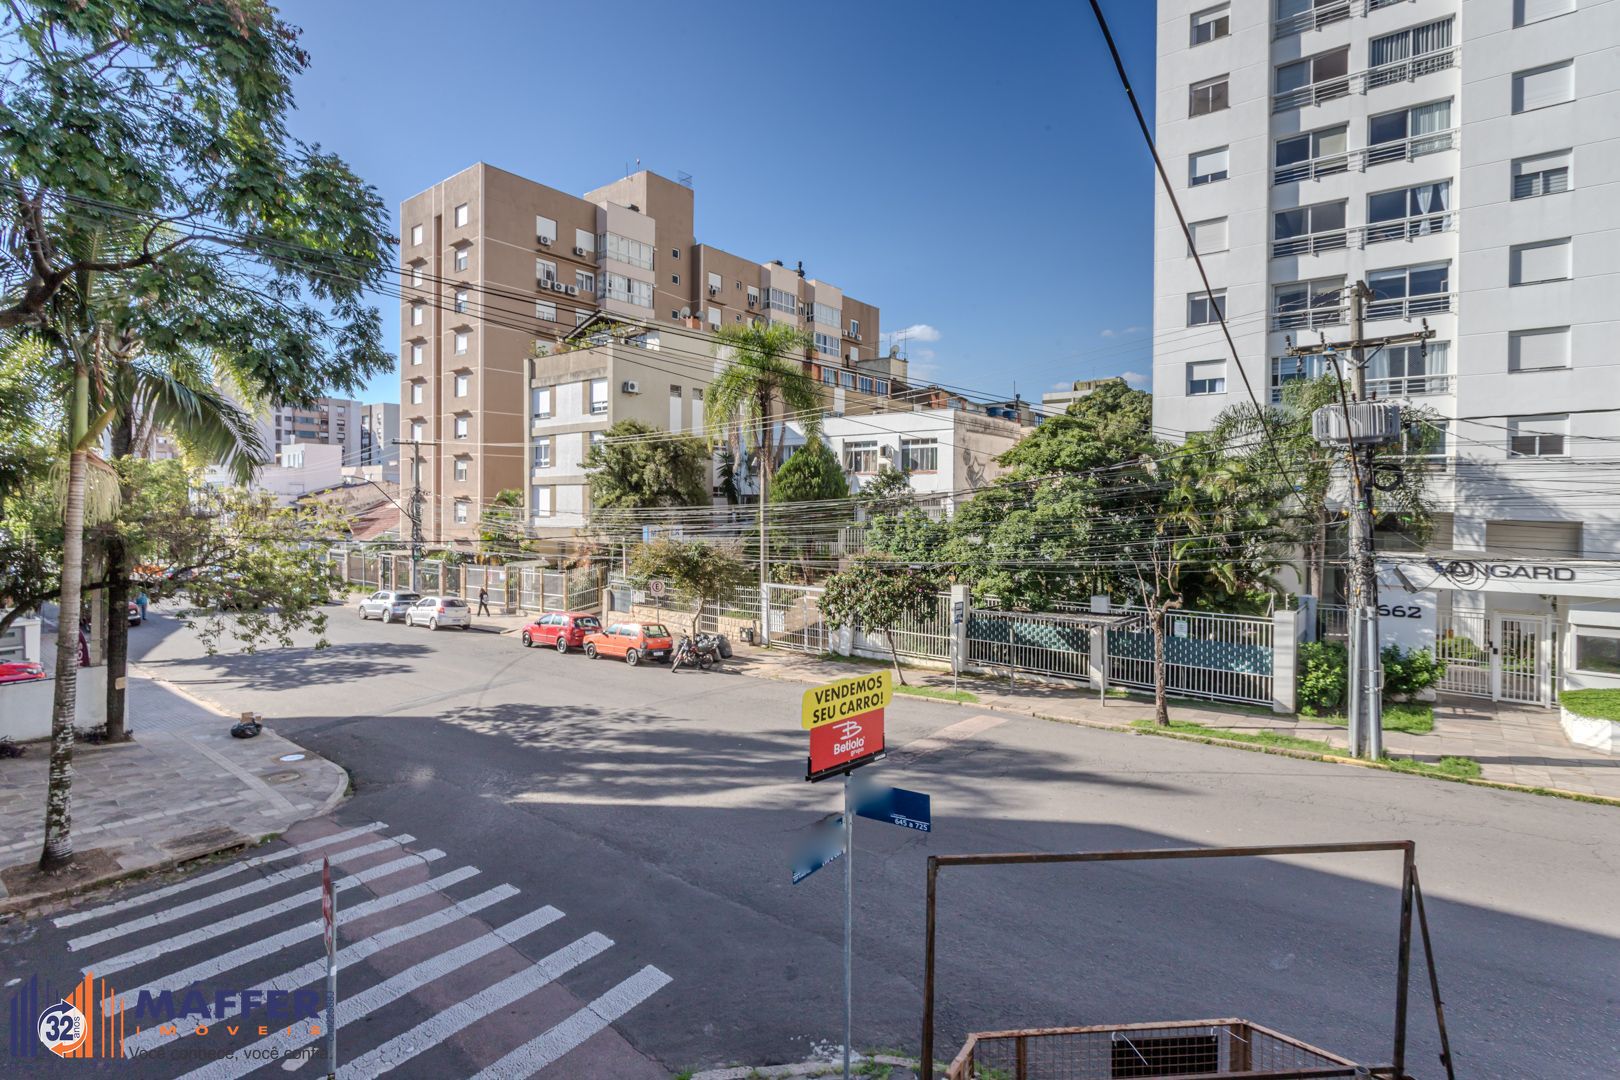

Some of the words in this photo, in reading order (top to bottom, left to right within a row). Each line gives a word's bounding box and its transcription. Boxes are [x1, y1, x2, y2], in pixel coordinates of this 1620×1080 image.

[1434, 560, 1576, 581] ANGARD
[1378, 604, 1422, 619] 662
[815, 676, 883, 705] VENDEMOS
[812, 705, 836, 724] SEU
[839, 692, 884, 716] CARRO!
[833, 737, 865, 755] Betiolo
[915, 822, 928, 831] 725
